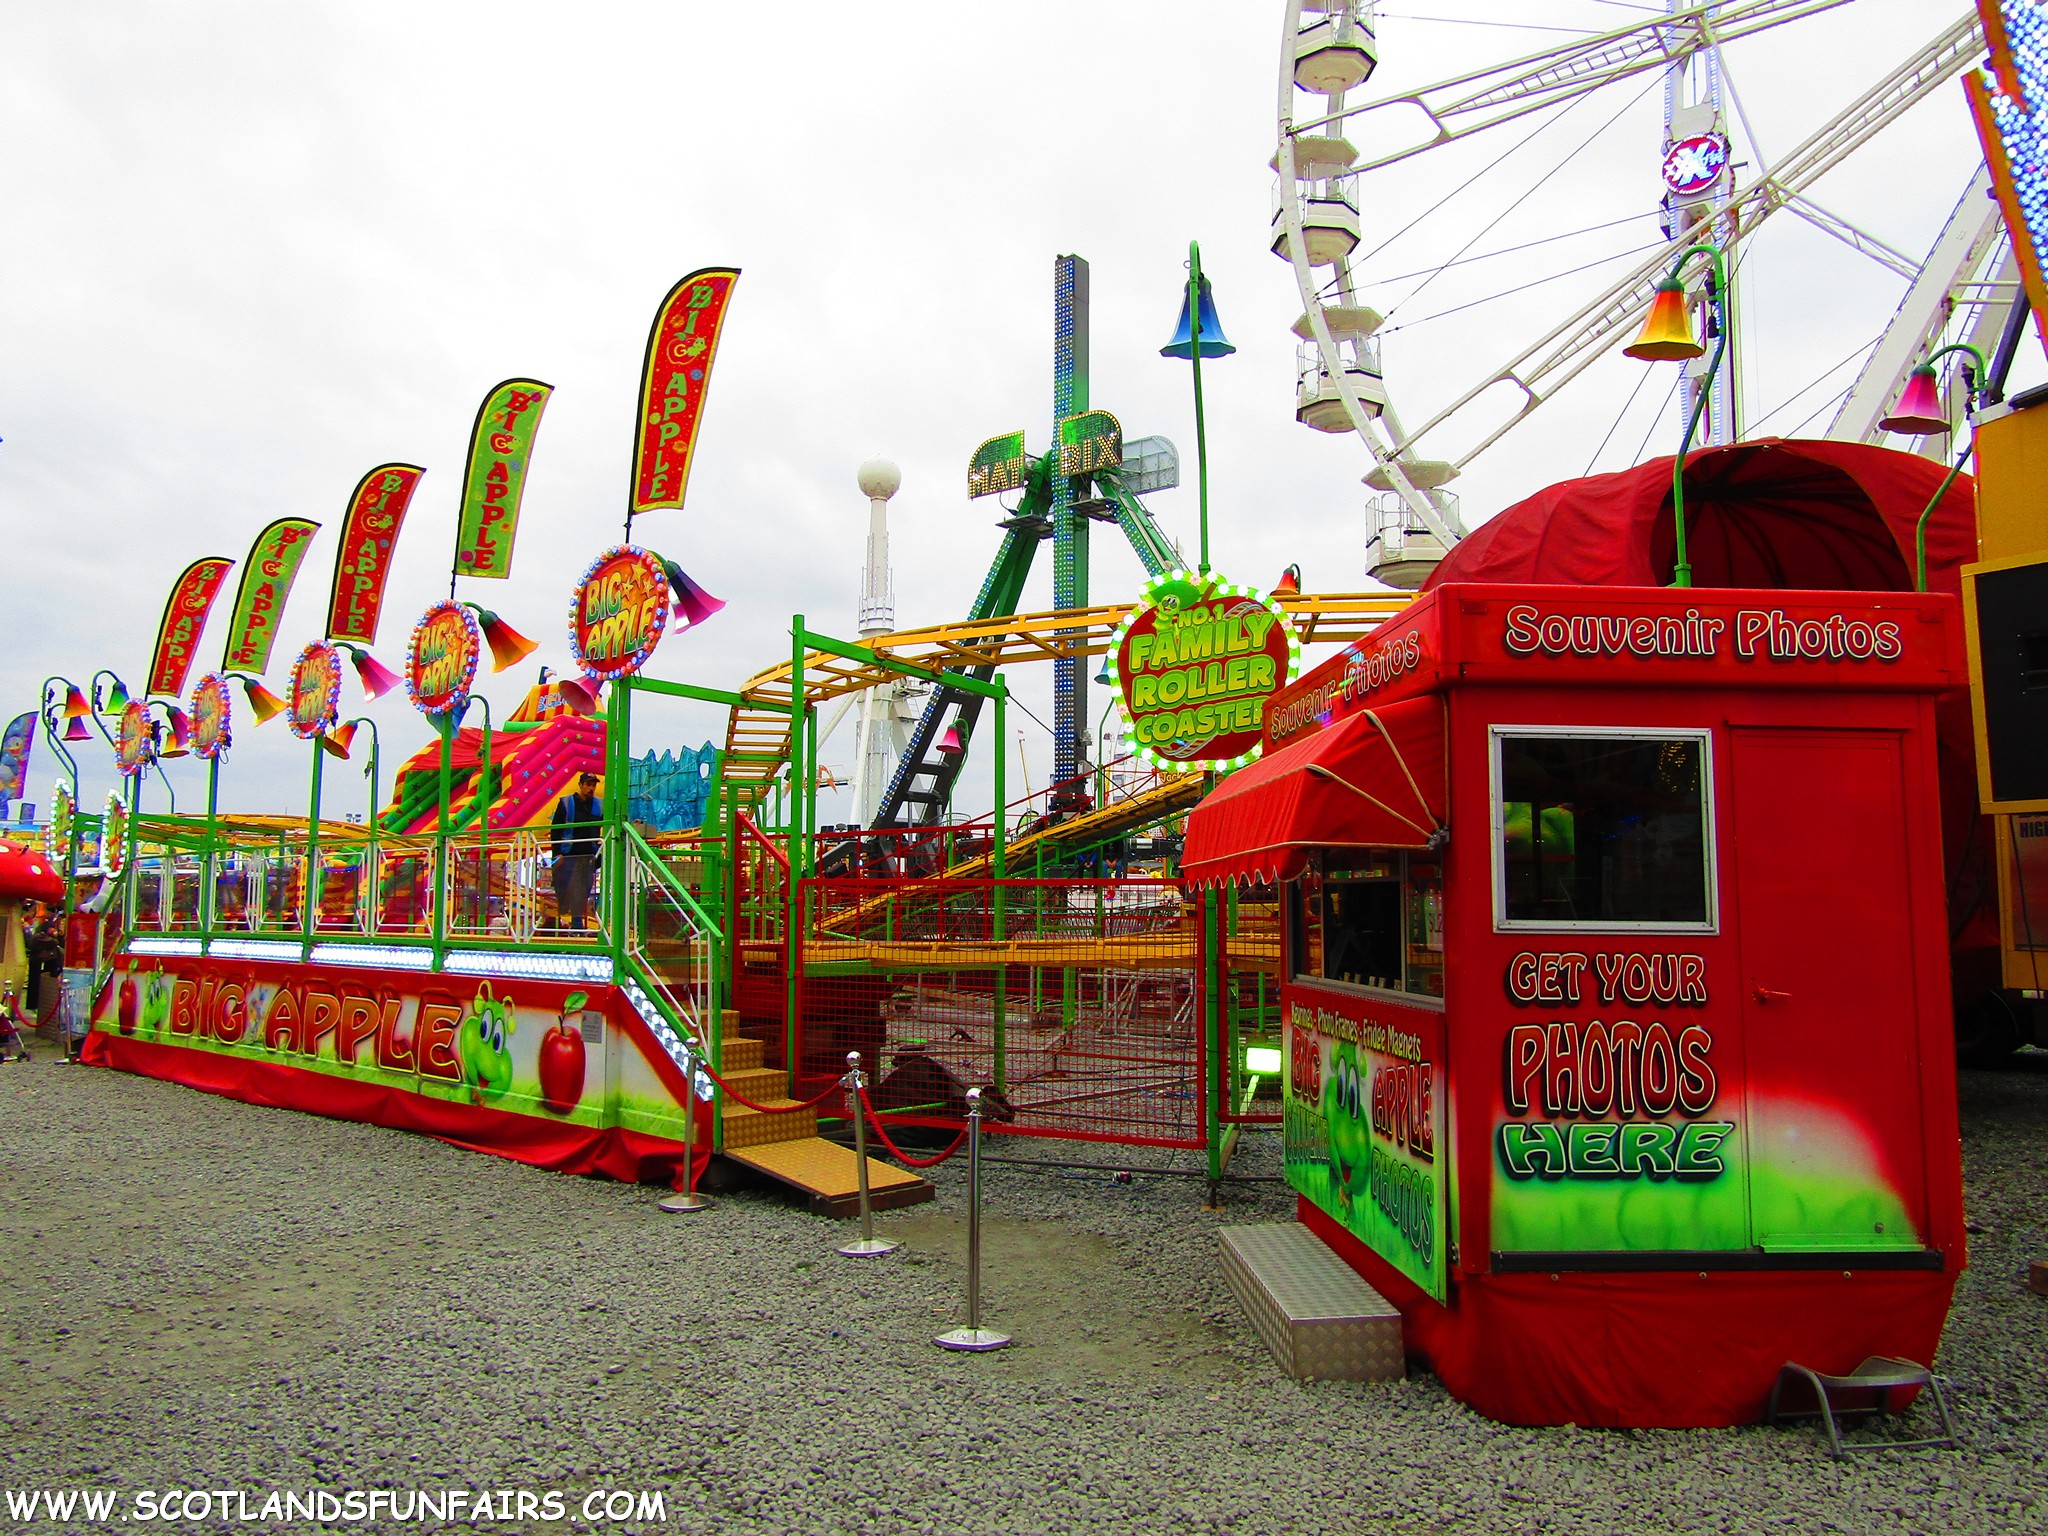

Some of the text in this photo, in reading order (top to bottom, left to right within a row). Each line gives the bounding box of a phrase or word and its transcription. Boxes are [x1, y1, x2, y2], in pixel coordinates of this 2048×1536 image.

[650, 285, 713, 500] BIG APPLE
[474, 389, 530, 569] BIG APPLE
[1060, 430, 1121, 478] RIX
[346, 473, 403, 634] BIG APPLE
[237, 526, 302, 665] BIG APPLE
[585, 571, 622, 626] BIG
[1178, 603, 1225, 630] NO.1
[161, 616, 192, 691] APPLE
[420, 621, 448, 667] BIG
[584, 595, 657, 661] APPLE
[1129, 611, 1275, 673] FAMILY
[1506, 604, 1902, 660] Souvenir Photos
[1131, 654, 1276, 713] ROLLER
[1270, 630, 1420, 740] Souvenir Photos
[2019, 820, 2048, 838] HIG
[1509, 952, 1707, 1003] GET YOUR
[169, 977, 248, 1046] BIG
[264, 986, 463, 1083] APPLE
[1363, 1018, 1386, 1052] Fridge
[1387, 1024, 1421, 1063] Magnets
[1291, 1024, 1434, 1158] BIG APPLE
[1509, 1020, 1716, 1116] PHOTOS
[1501, 1122, 1735, 1176] HERE
[1371, 1147, 1434, 1264] PHOTOS
